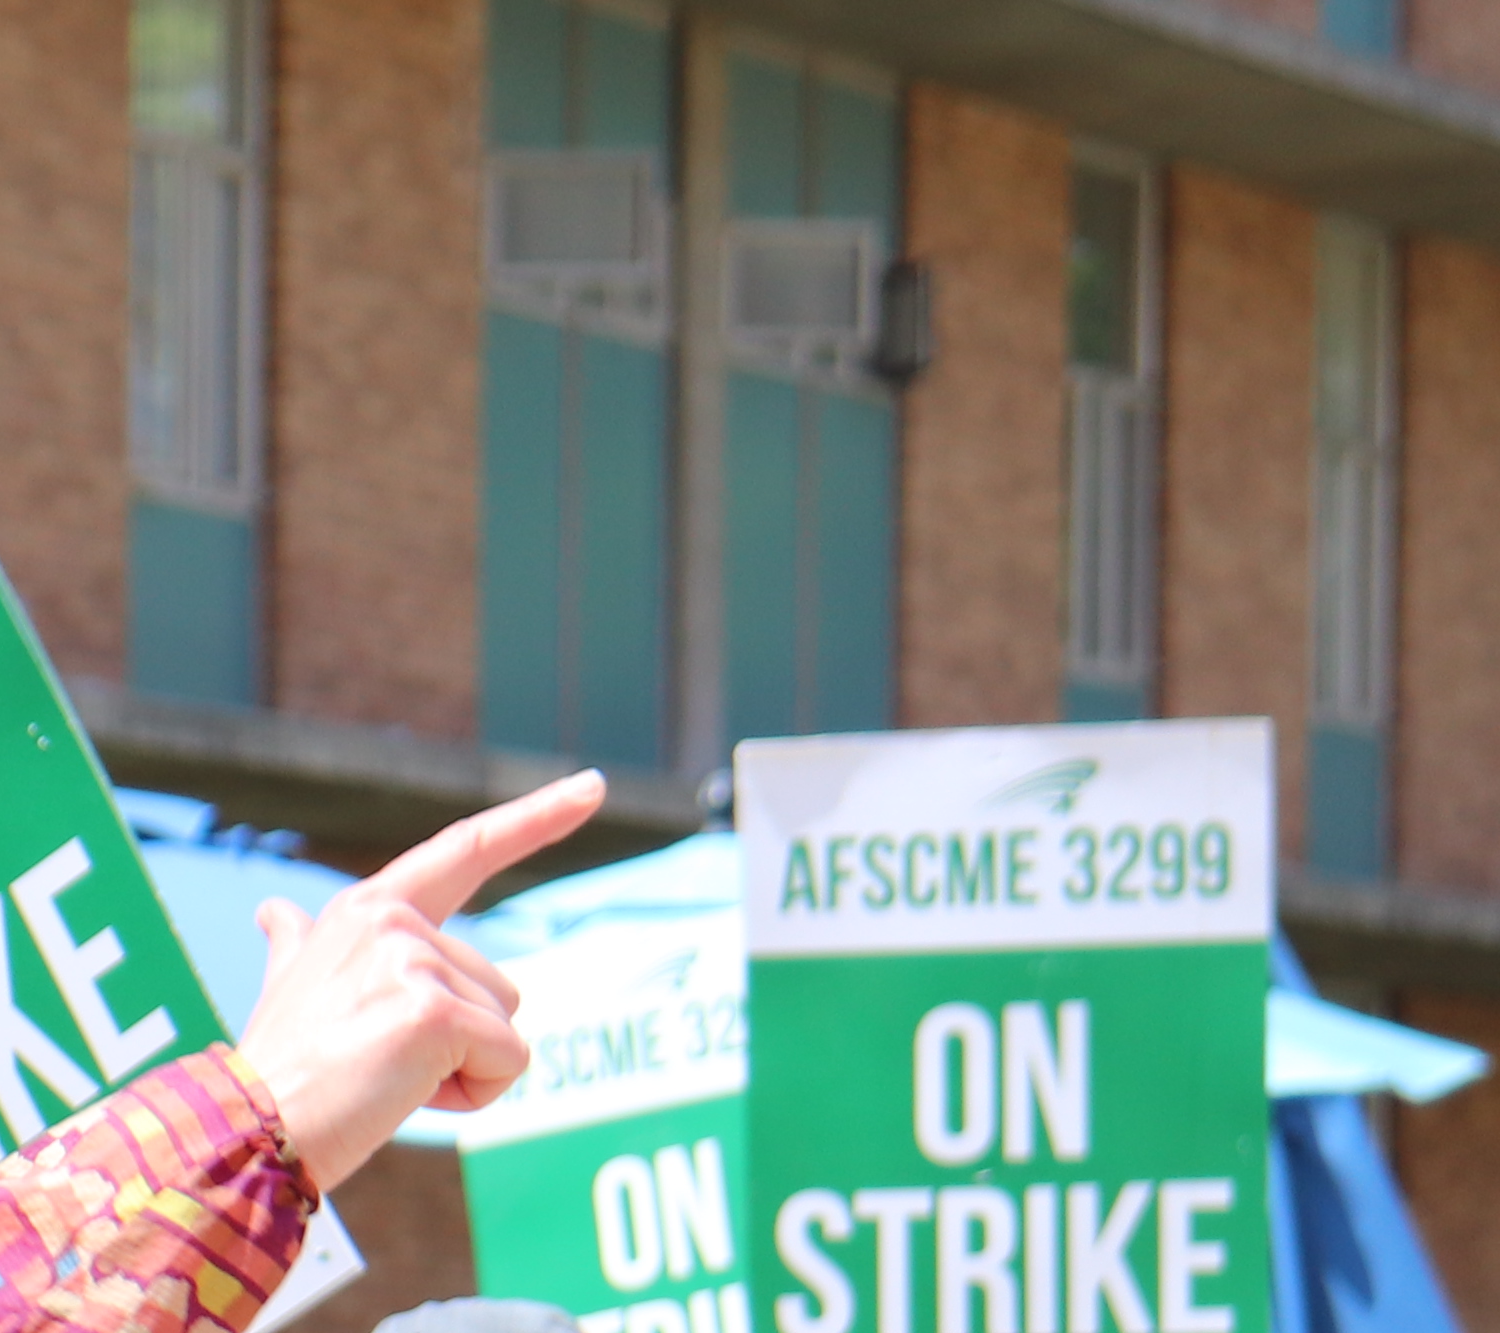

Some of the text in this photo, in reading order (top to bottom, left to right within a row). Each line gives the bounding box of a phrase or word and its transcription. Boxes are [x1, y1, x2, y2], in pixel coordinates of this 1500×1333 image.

[779, 822, 1233, 913] AFSCME 3299
[912, 1000, 1090, 1166] ON
[591, 1135, 735, 1292] ON
